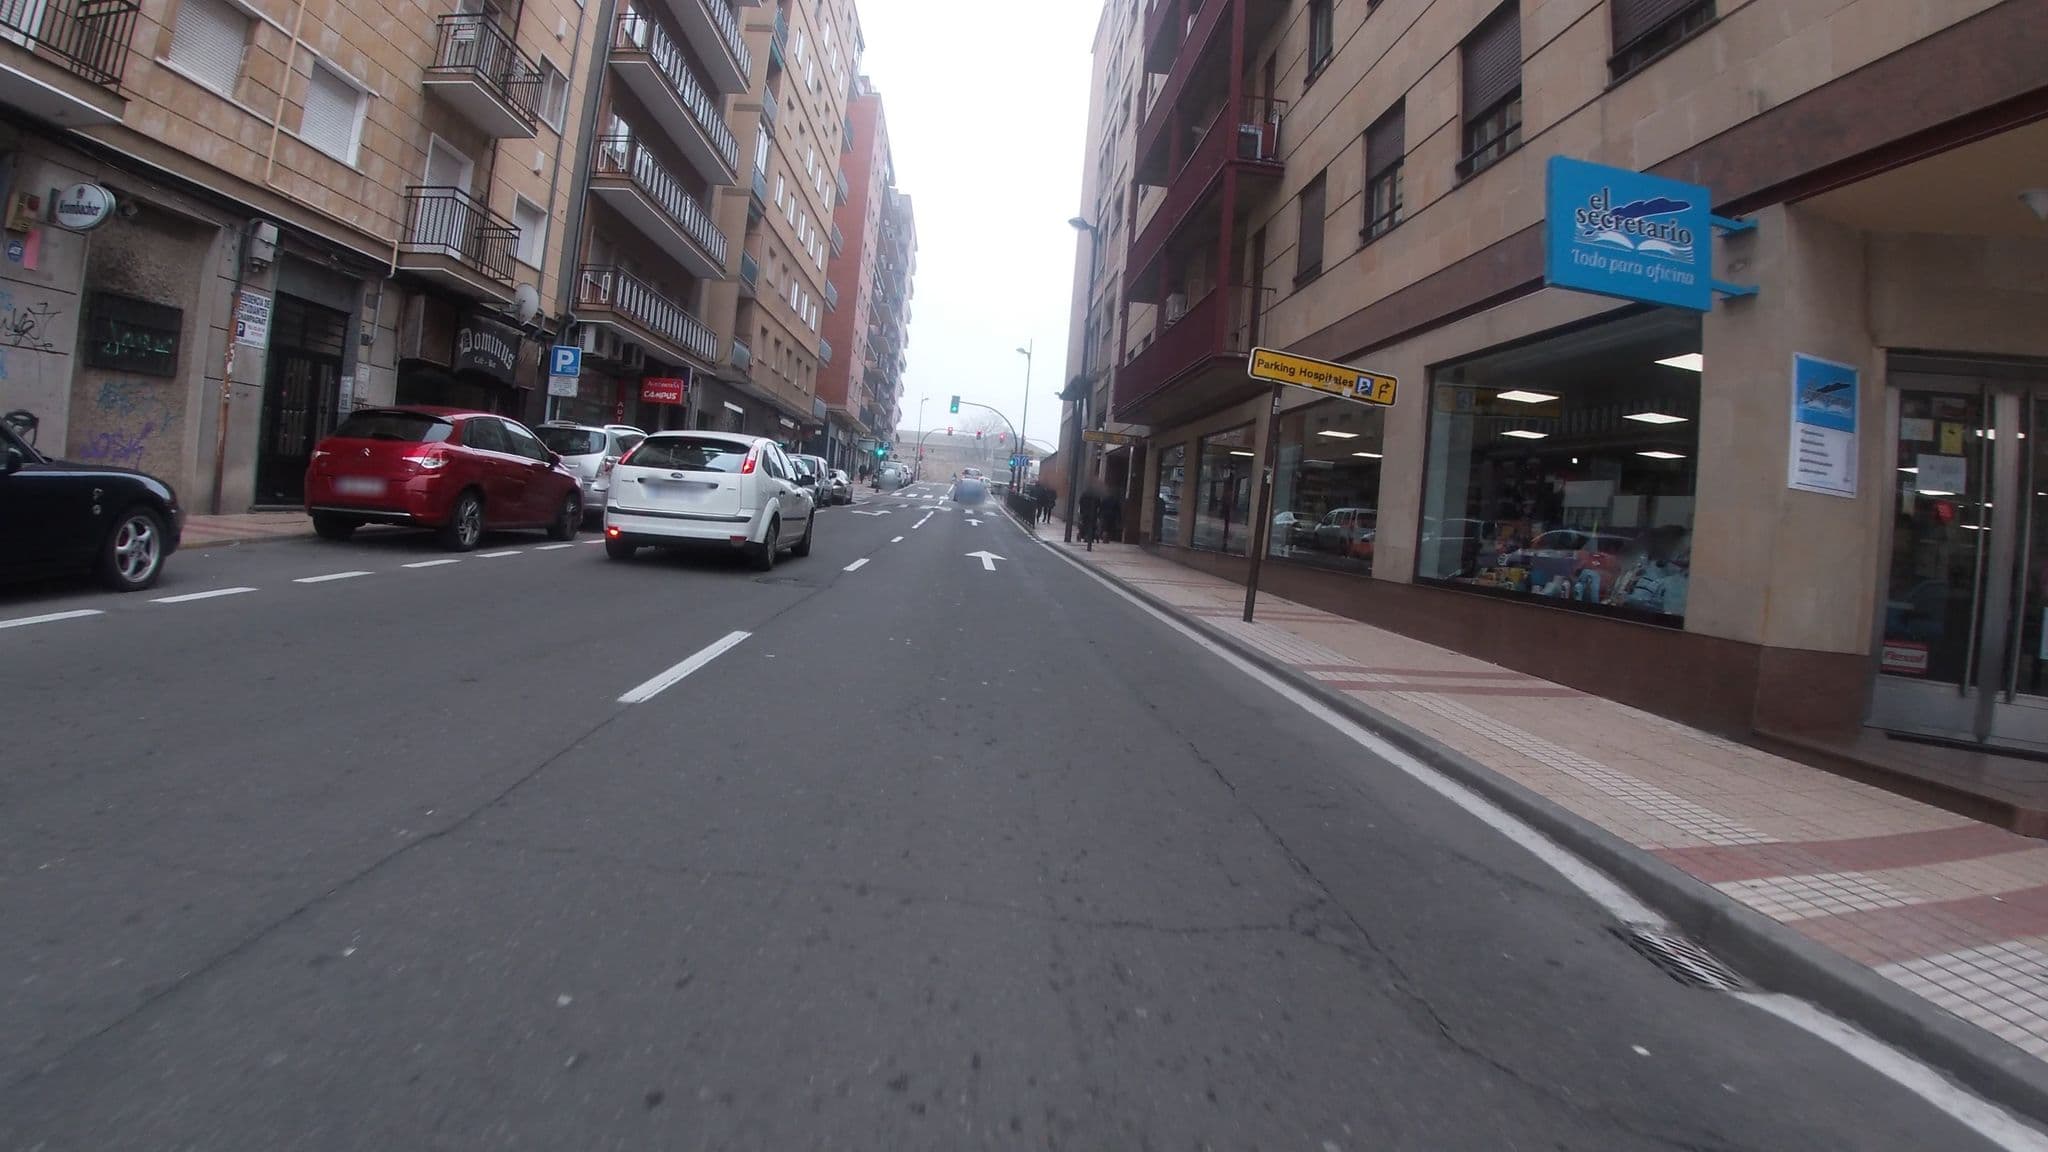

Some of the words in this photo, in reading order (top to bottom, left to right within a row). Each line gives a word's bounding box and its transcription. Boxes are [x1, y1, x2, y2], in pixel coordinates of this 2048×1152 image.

[1590, 187, 1609, 211] el
[1577, 208, 1692, 245] secretario
[1572, 248, 1607, 269] Todo
[1609, 259, 1642, 275] para
[1646, 263, 1695, 285] oficina
[459, 328, 515, 370] Dominus
[556, 350, 574, 371] P
[1257, 359, 1296, 376] Parking
[1299, 367, 1354, 387] Hospitales
[644, 390, 678, 400] CAMPUS
